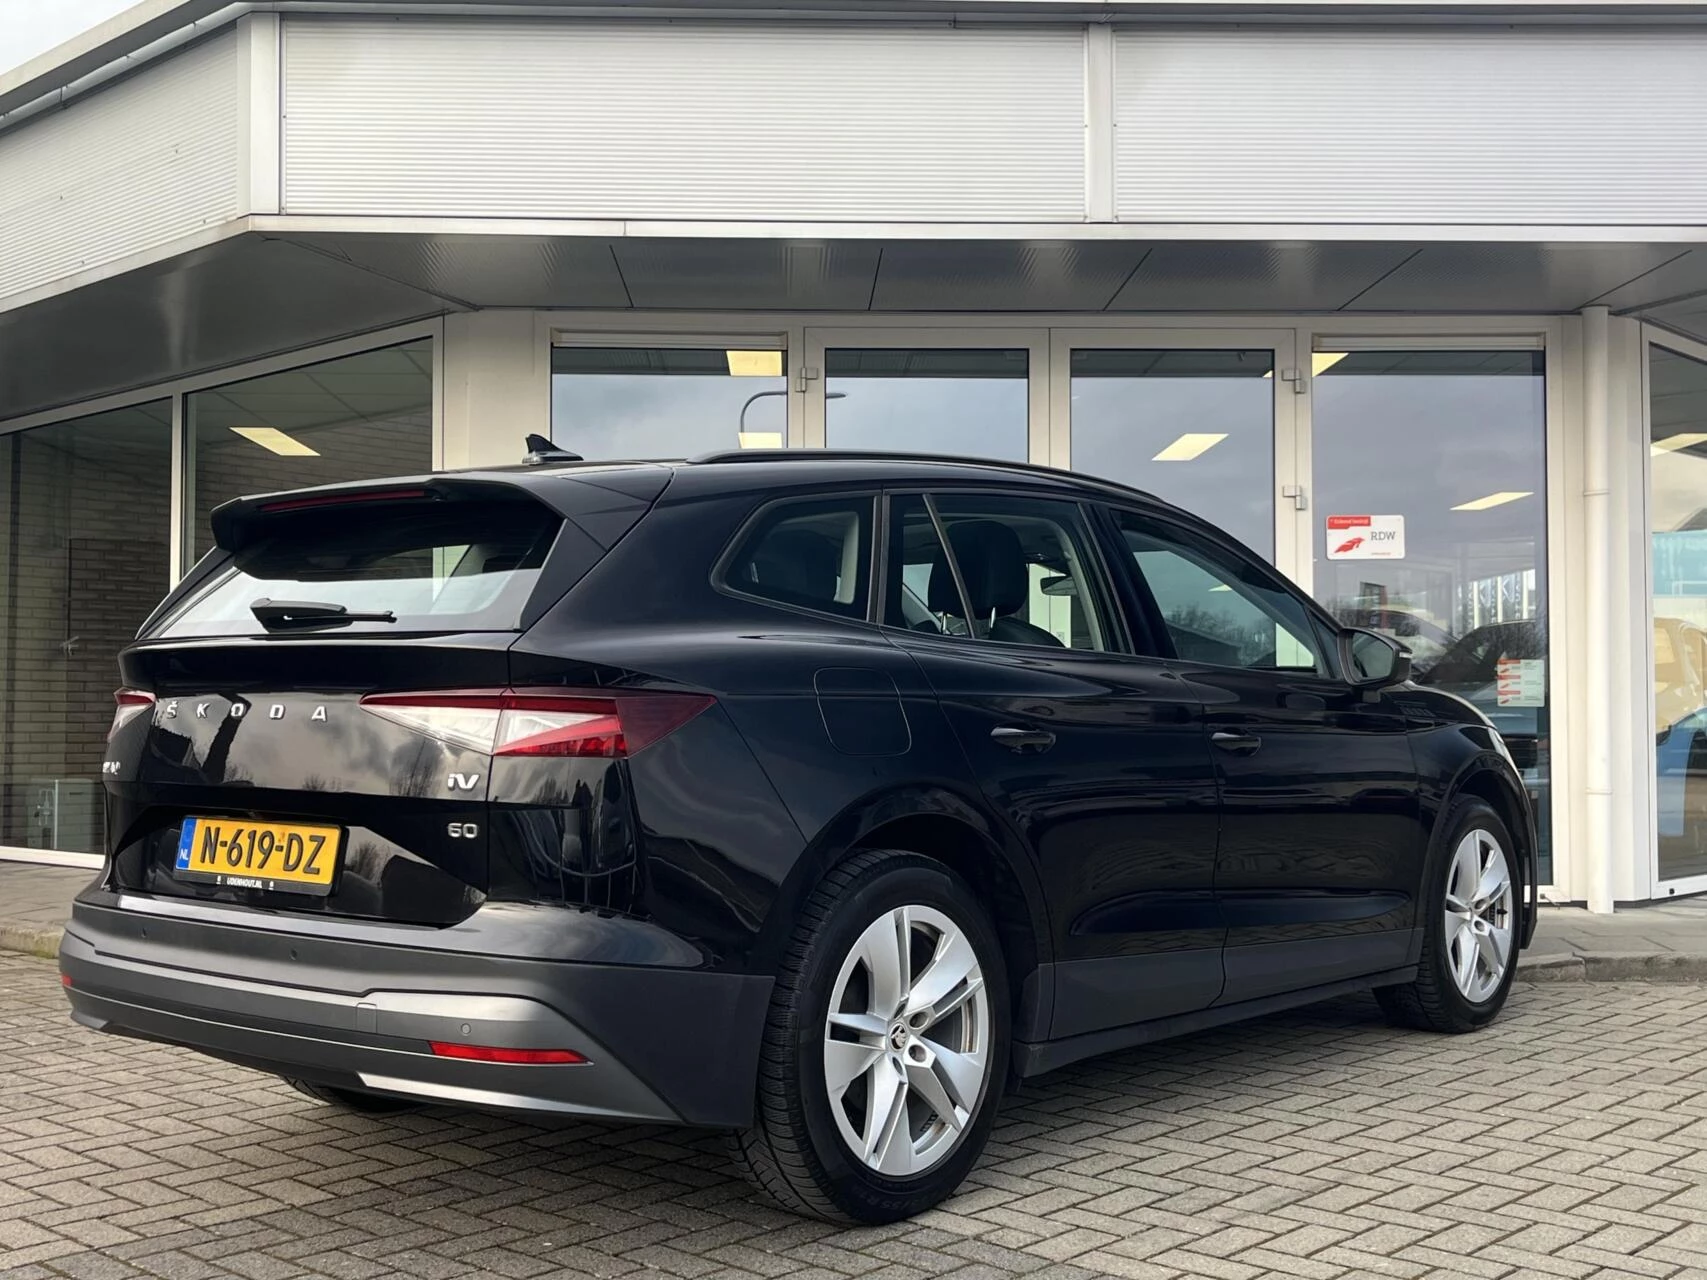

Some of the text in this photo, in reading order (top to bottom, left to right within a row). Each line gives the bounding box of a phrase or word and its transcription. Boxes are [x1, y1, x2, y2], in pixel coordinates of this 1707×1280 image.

[1370, 531, 1396, 541] RDW
[165, 700, 328, 722] ŠKODA
[447, 822, 478, 839] 60
[179, 849, 189, 860] NL
[200, 826, 326, 875] N-619-DZ
